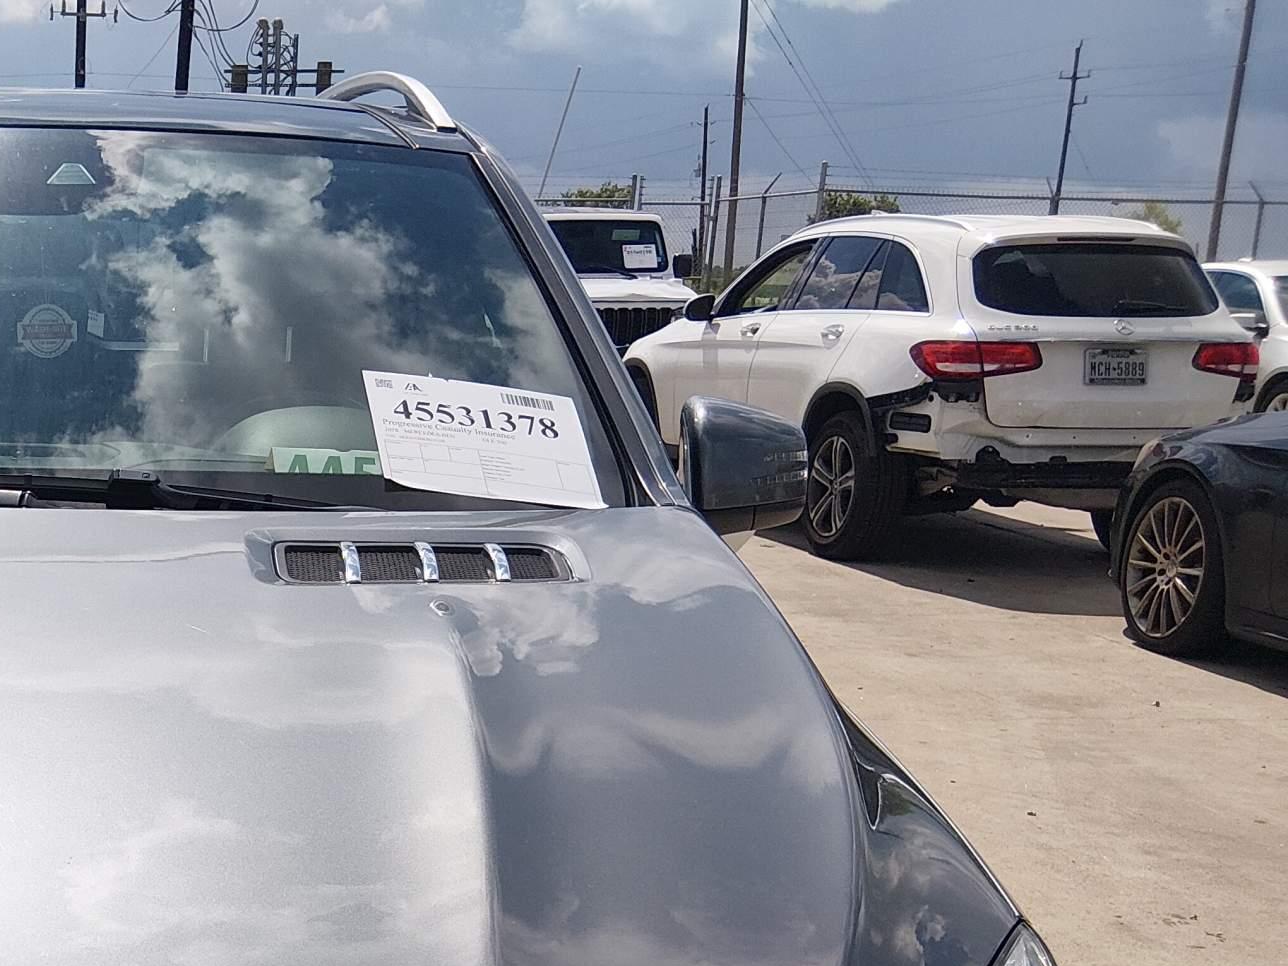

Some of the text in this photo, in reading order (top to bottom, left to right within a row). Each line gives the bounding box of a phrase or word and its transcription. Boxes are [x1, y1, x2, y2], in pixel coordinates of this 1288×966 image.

[383, 418, 433, 430] Progressive
[474, 427, 516, 440] Insurance
[393, 399, 559, 439] 45531378
